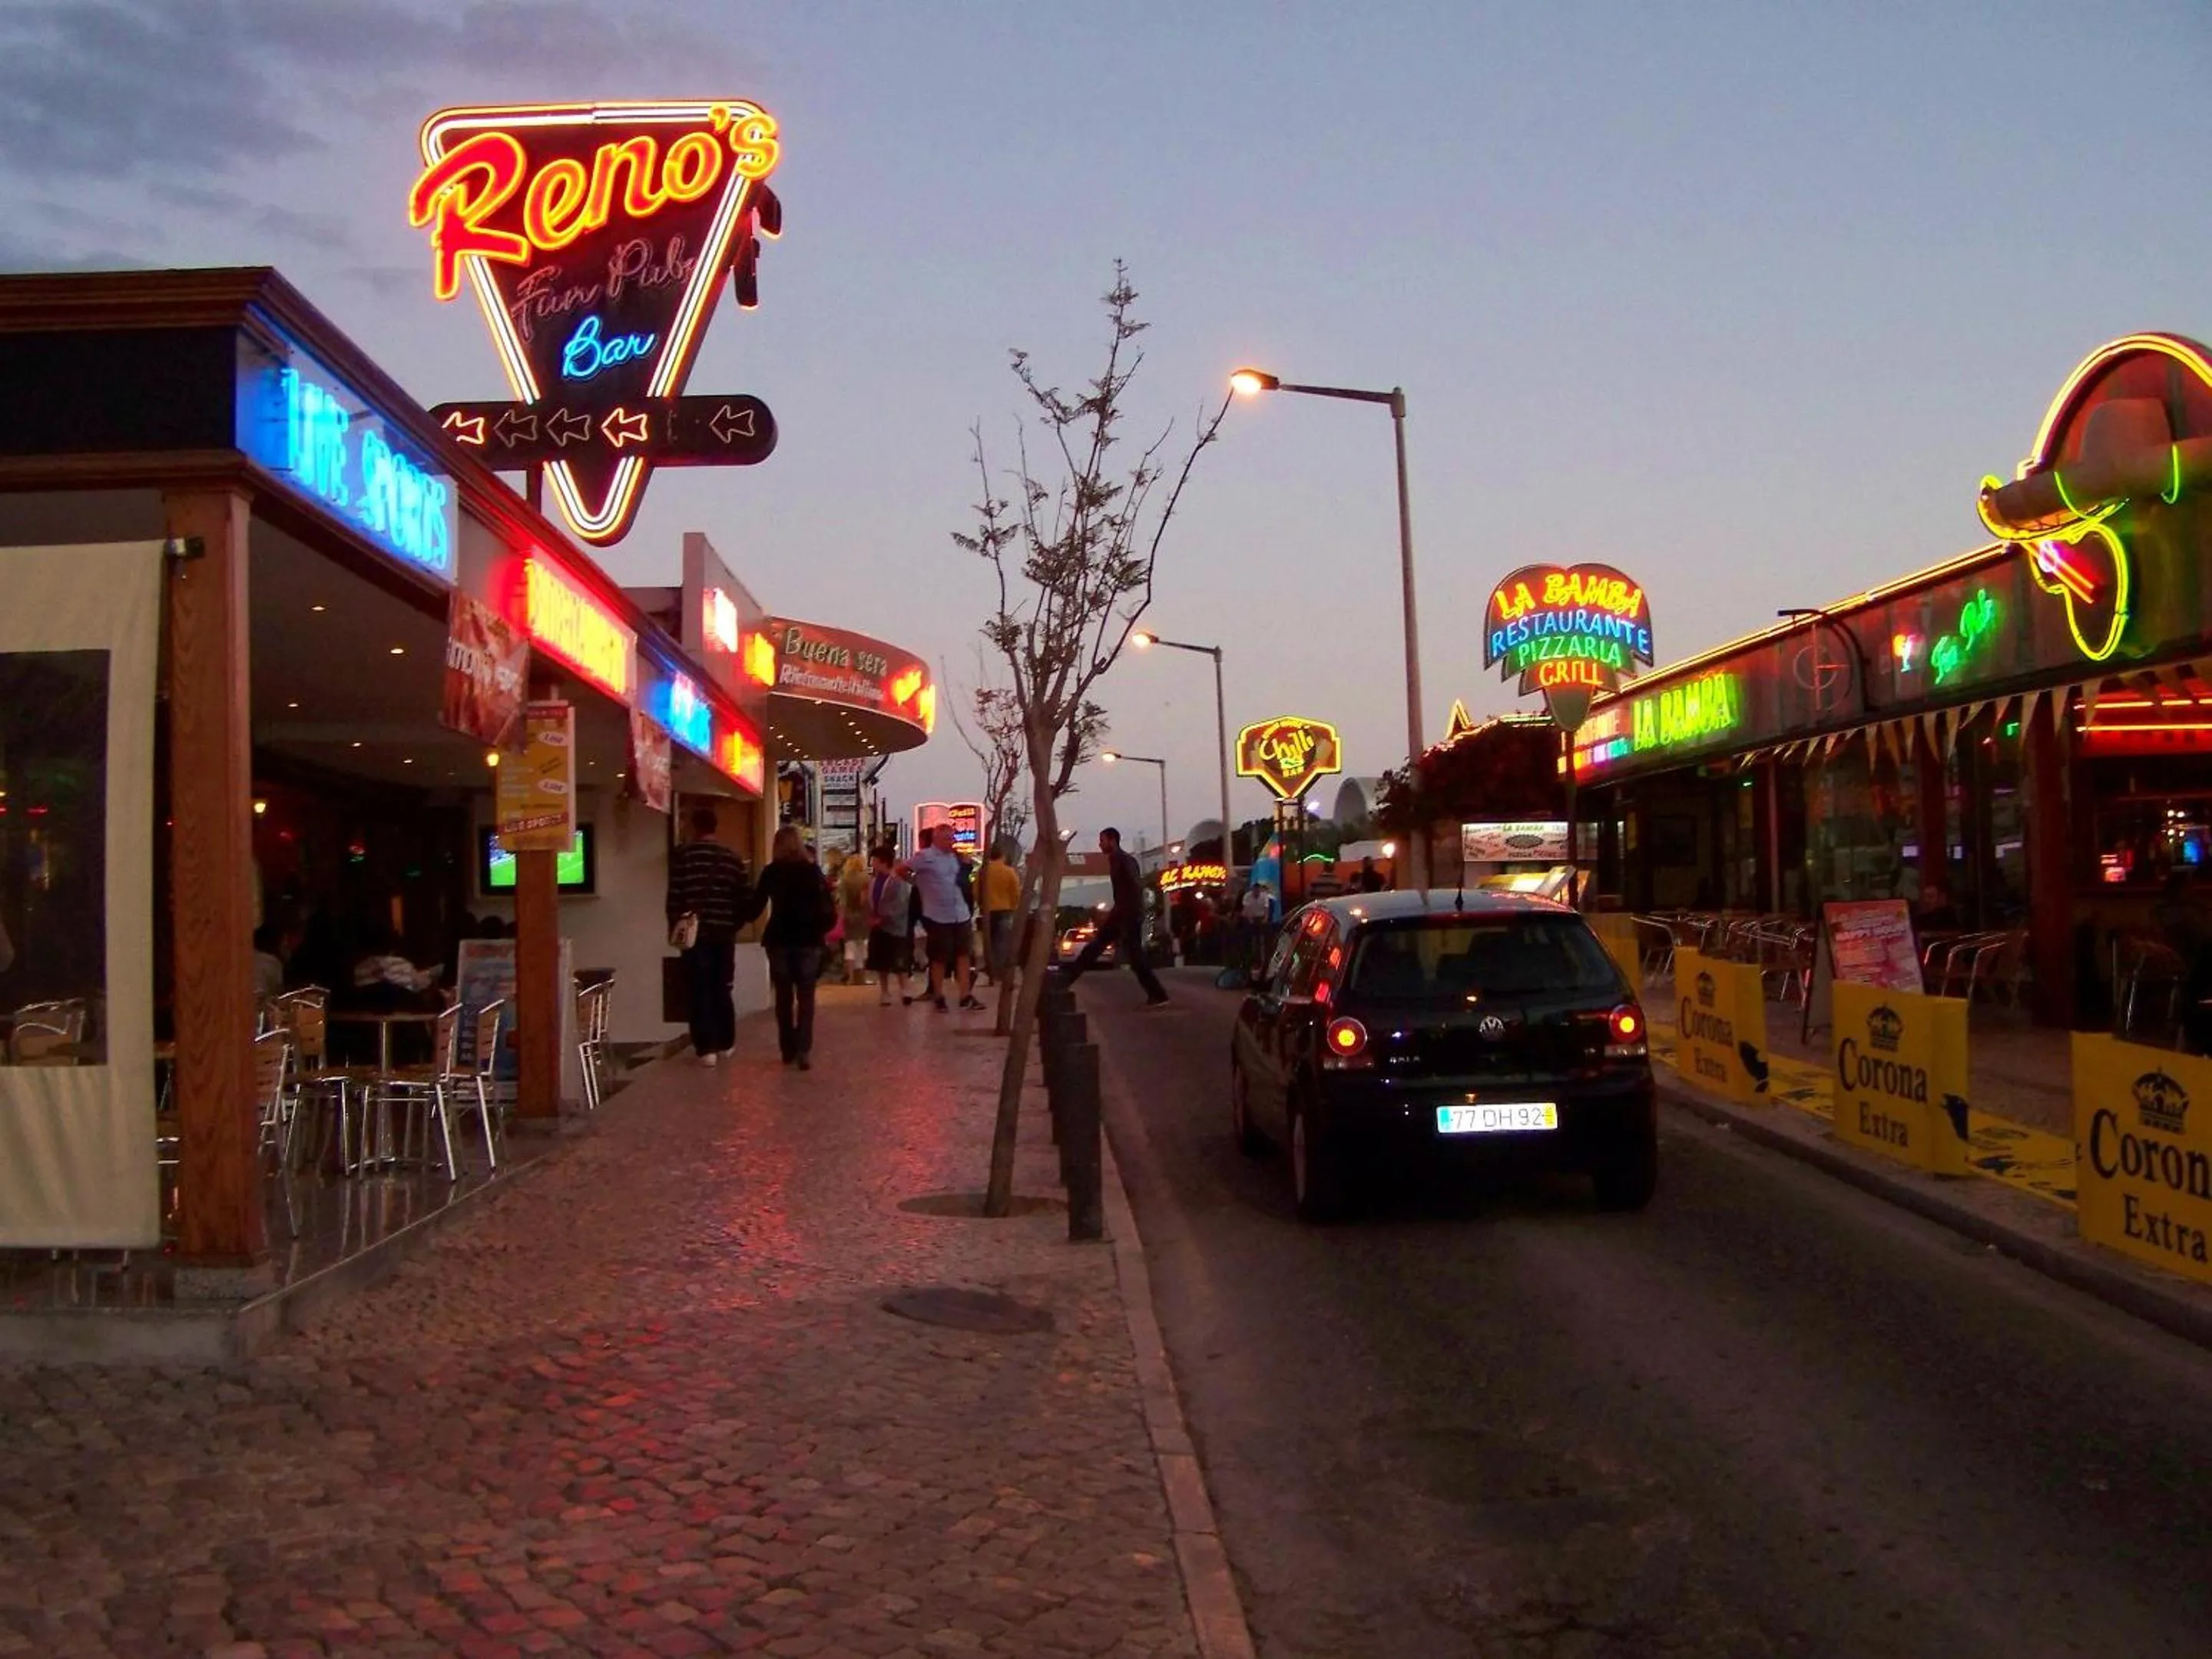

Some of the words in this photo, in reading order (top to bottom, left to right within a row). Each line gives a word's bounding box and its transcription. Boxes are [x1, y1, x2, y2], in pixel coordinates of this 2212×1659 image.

[409, 104, 780, 303] Reno's
[510, 265, 602, 343] Fun
[562, 314, 657, 378] Bar
[1495, 581, 1536, 621] LA
[1542, 572, 1642, 619] BAMBA
[784, 626, 850, 668] Buena
[1490, 608, 1651, 657] RESTAURANTE
[1517, 634, 1623, 669] PIZZARIA
[1538, 660, 1604, 687] GRILL
[1633, 695, 1657, 751] LA
[1659, 673, 1736, 745] BAMBA
[1681, 995, 1734, 1048] Corona
[1693, 1046, 1728, 1084] Extra
[1839, 1038, 1928, 1104] Corona
[1858, 1101, 1909, 1147] Extra
[2123, 1192, 2210, 1263] Extra
